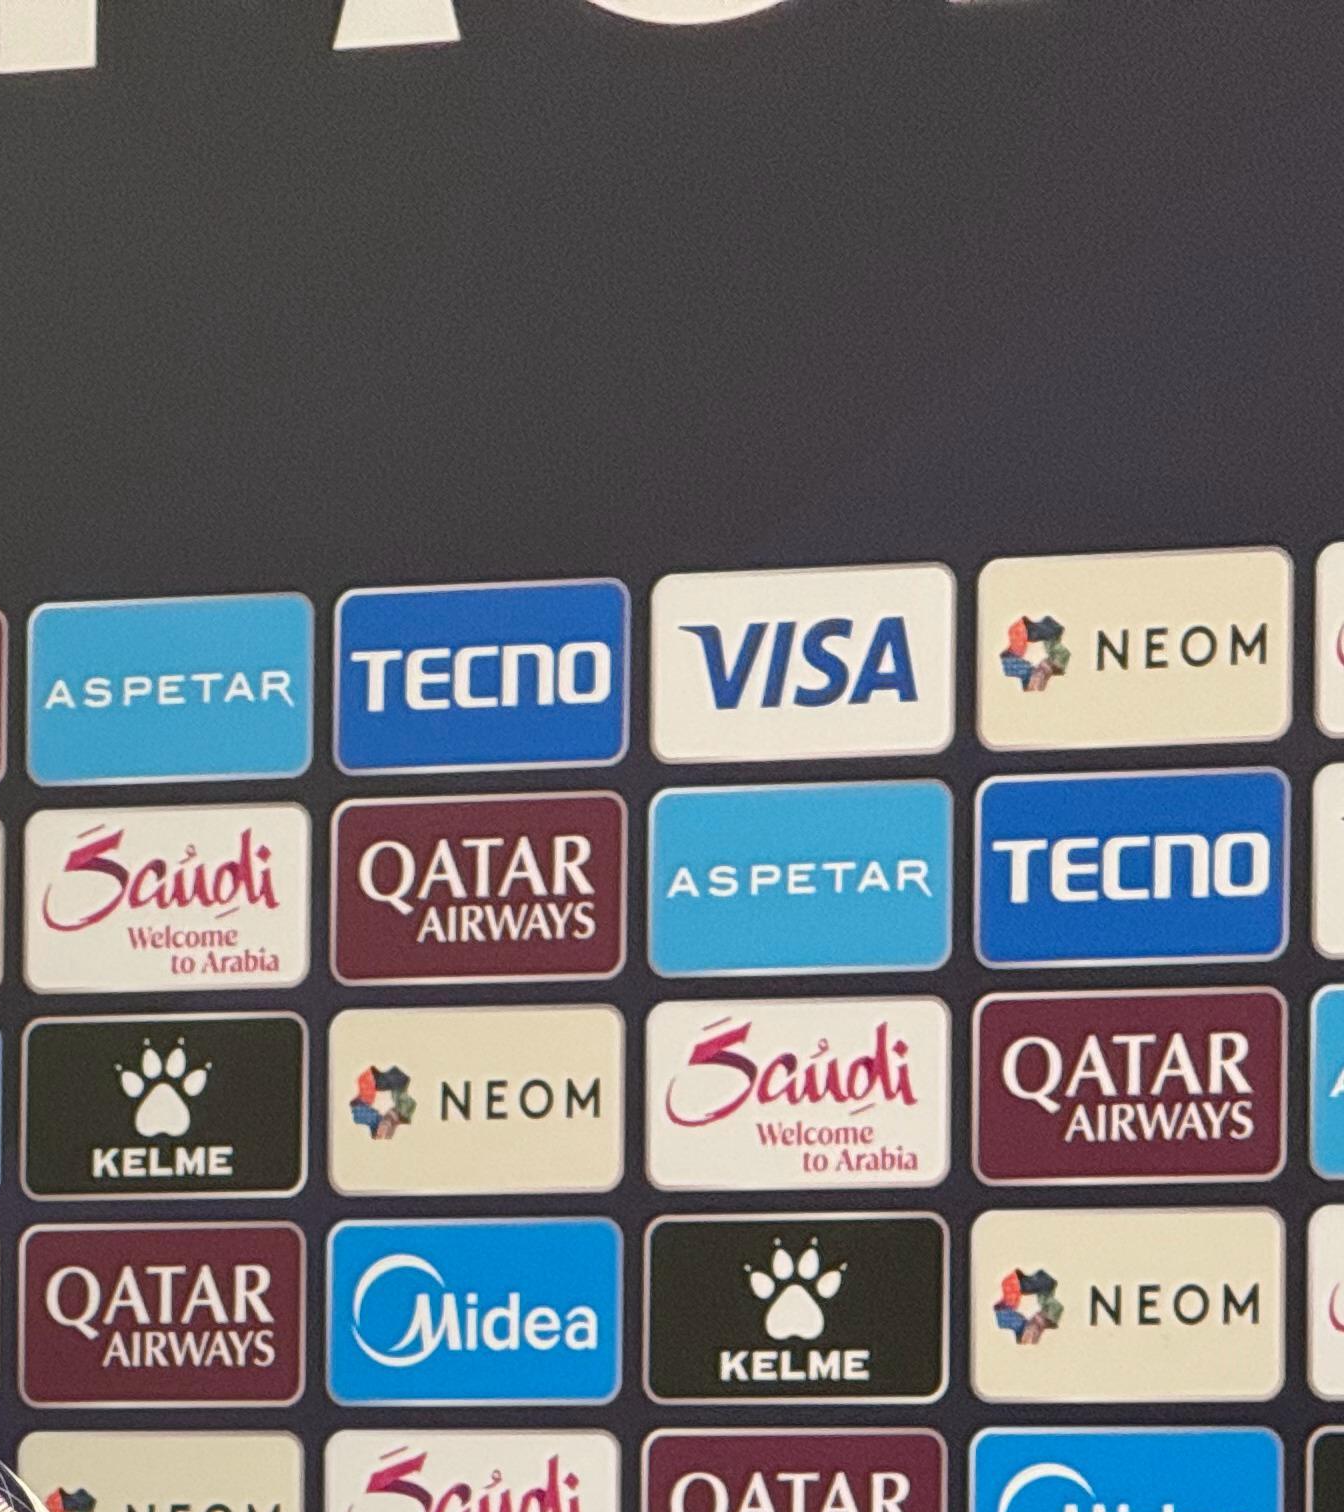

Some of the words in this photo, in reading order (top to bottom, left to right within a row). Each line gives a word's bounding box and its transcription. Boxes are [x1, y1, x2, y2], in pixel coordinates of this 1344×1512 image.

[678, 616, 918, 709] VISA
[1096, 622, 1269, 672] NEOM
[45, 671, 295, 708] ASPETAR
[350, 641, 611, 712] TECNO
[43, 824, 280, 931] Saudi
[357, 835, 595, 915] QATAR
[667, 860, 933, 898] ASPETAR
[992, 832, 1271, 903] TECNO
[128, 926, 238, 950] Welcome
[417, 902, 596, 944] AIRWAYS
[171, 953, 196, 976] to
[201, 949, 280, 973] Arabia
[666, 1017, 918, 1127] Saudi
[1003, 1032, 1253, 1113] QATAR
[440, 1077, 602, 1121] NEOM
[756, 1122, 874, 1147] Welcome
[1064, 1101, 1254, 1143] AIRWAYS
[91, 1147, 234, 1178] KELME
[802, 1150, 829, 1173] to
[835, 1146, 919, 1172] Arabia
[46, 1264, 275, 1340] QATAR
[389, 1292, 598, 1352] Midea
[1089, 1283, 1261, 1327] NEOM
[102, 1330, 276, 1369] AIRWAYS
[719, 1350, 869, 1382] KELME
